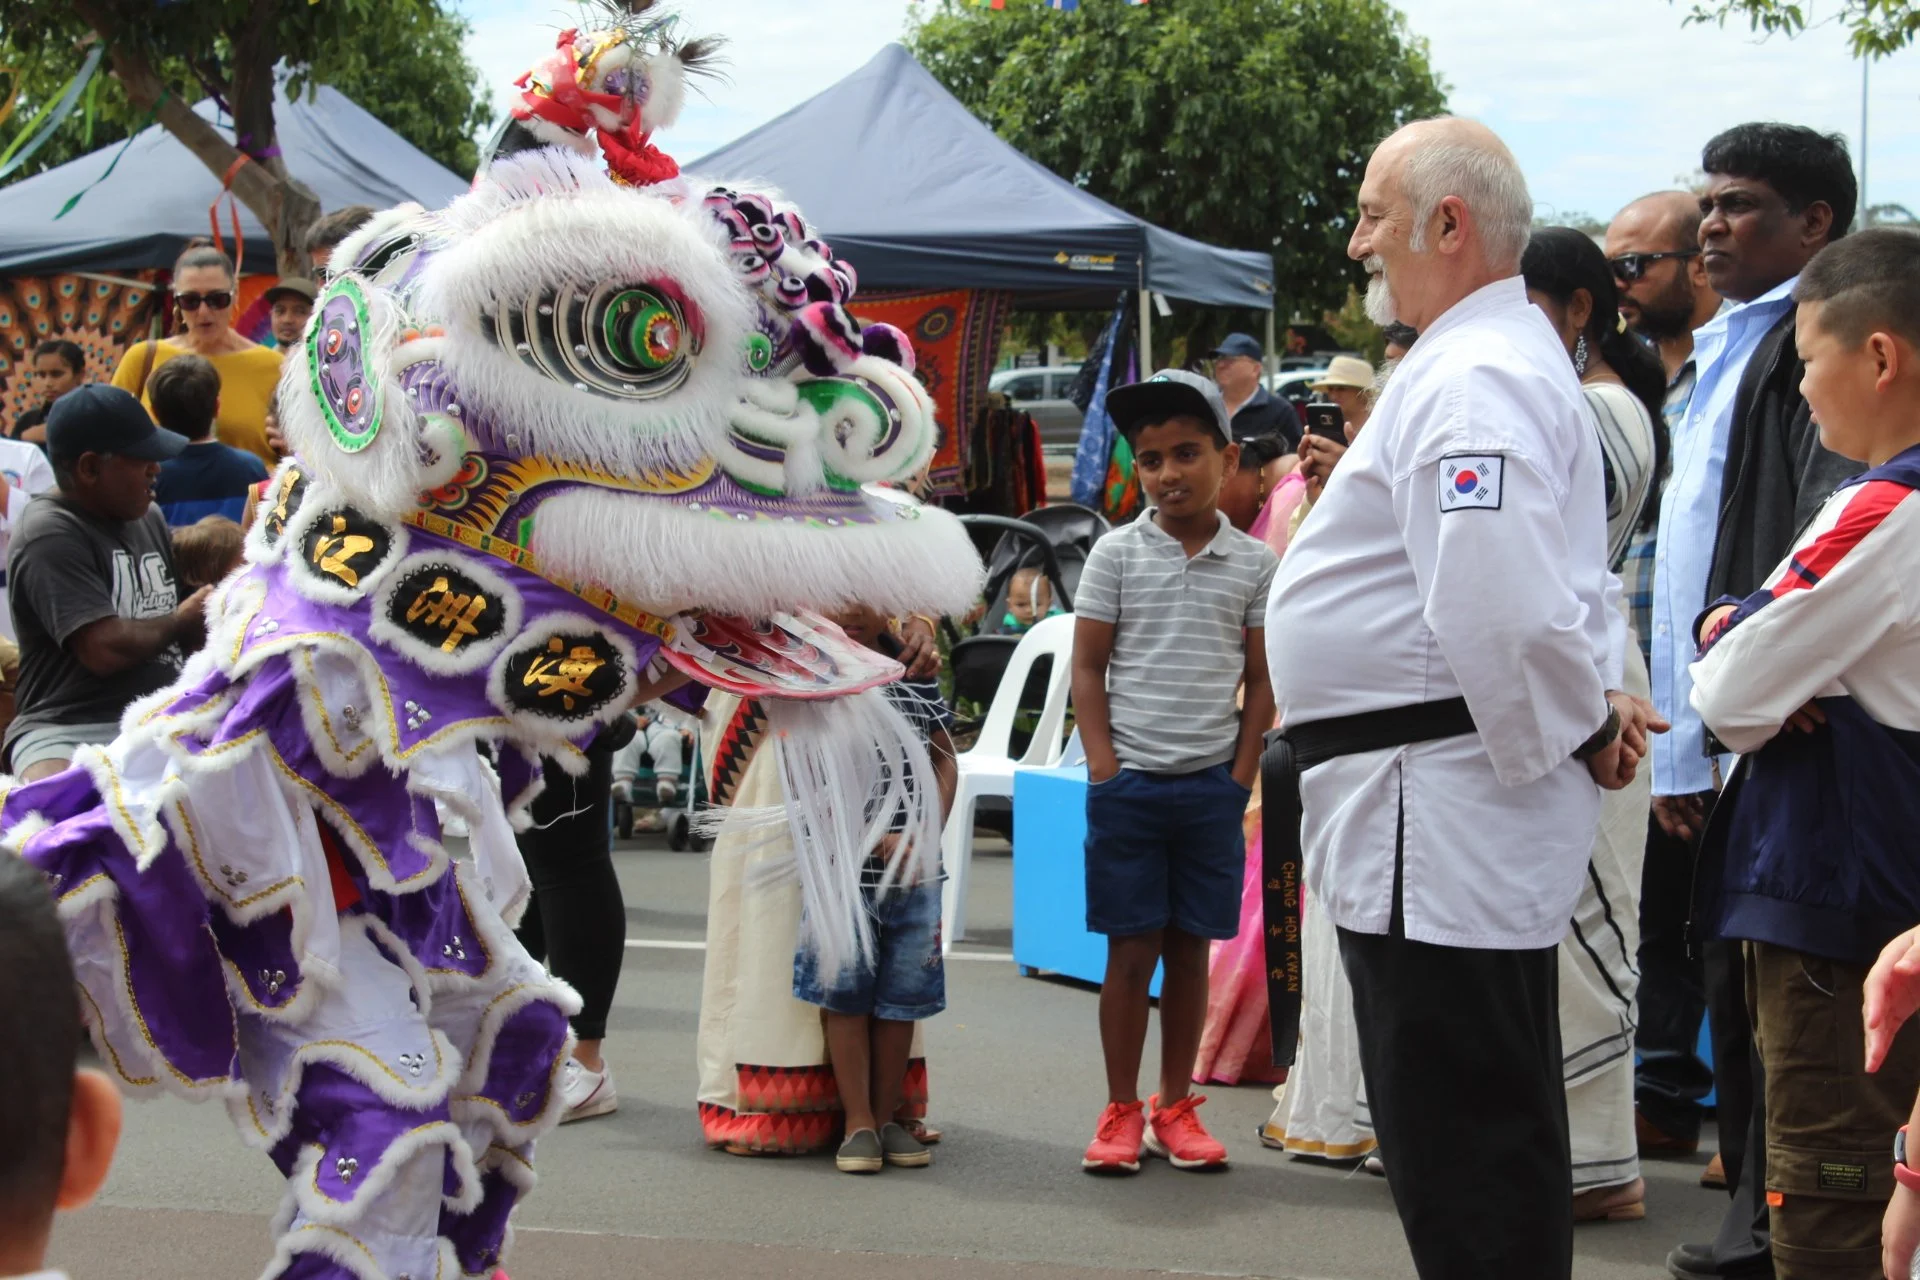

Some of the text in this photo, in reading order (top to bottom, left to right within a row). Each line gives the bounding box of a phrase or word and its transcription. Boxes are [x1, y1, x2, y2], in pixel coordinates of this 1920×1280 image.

[1281, 861, 1299, 992] CHANG HON KWAN
